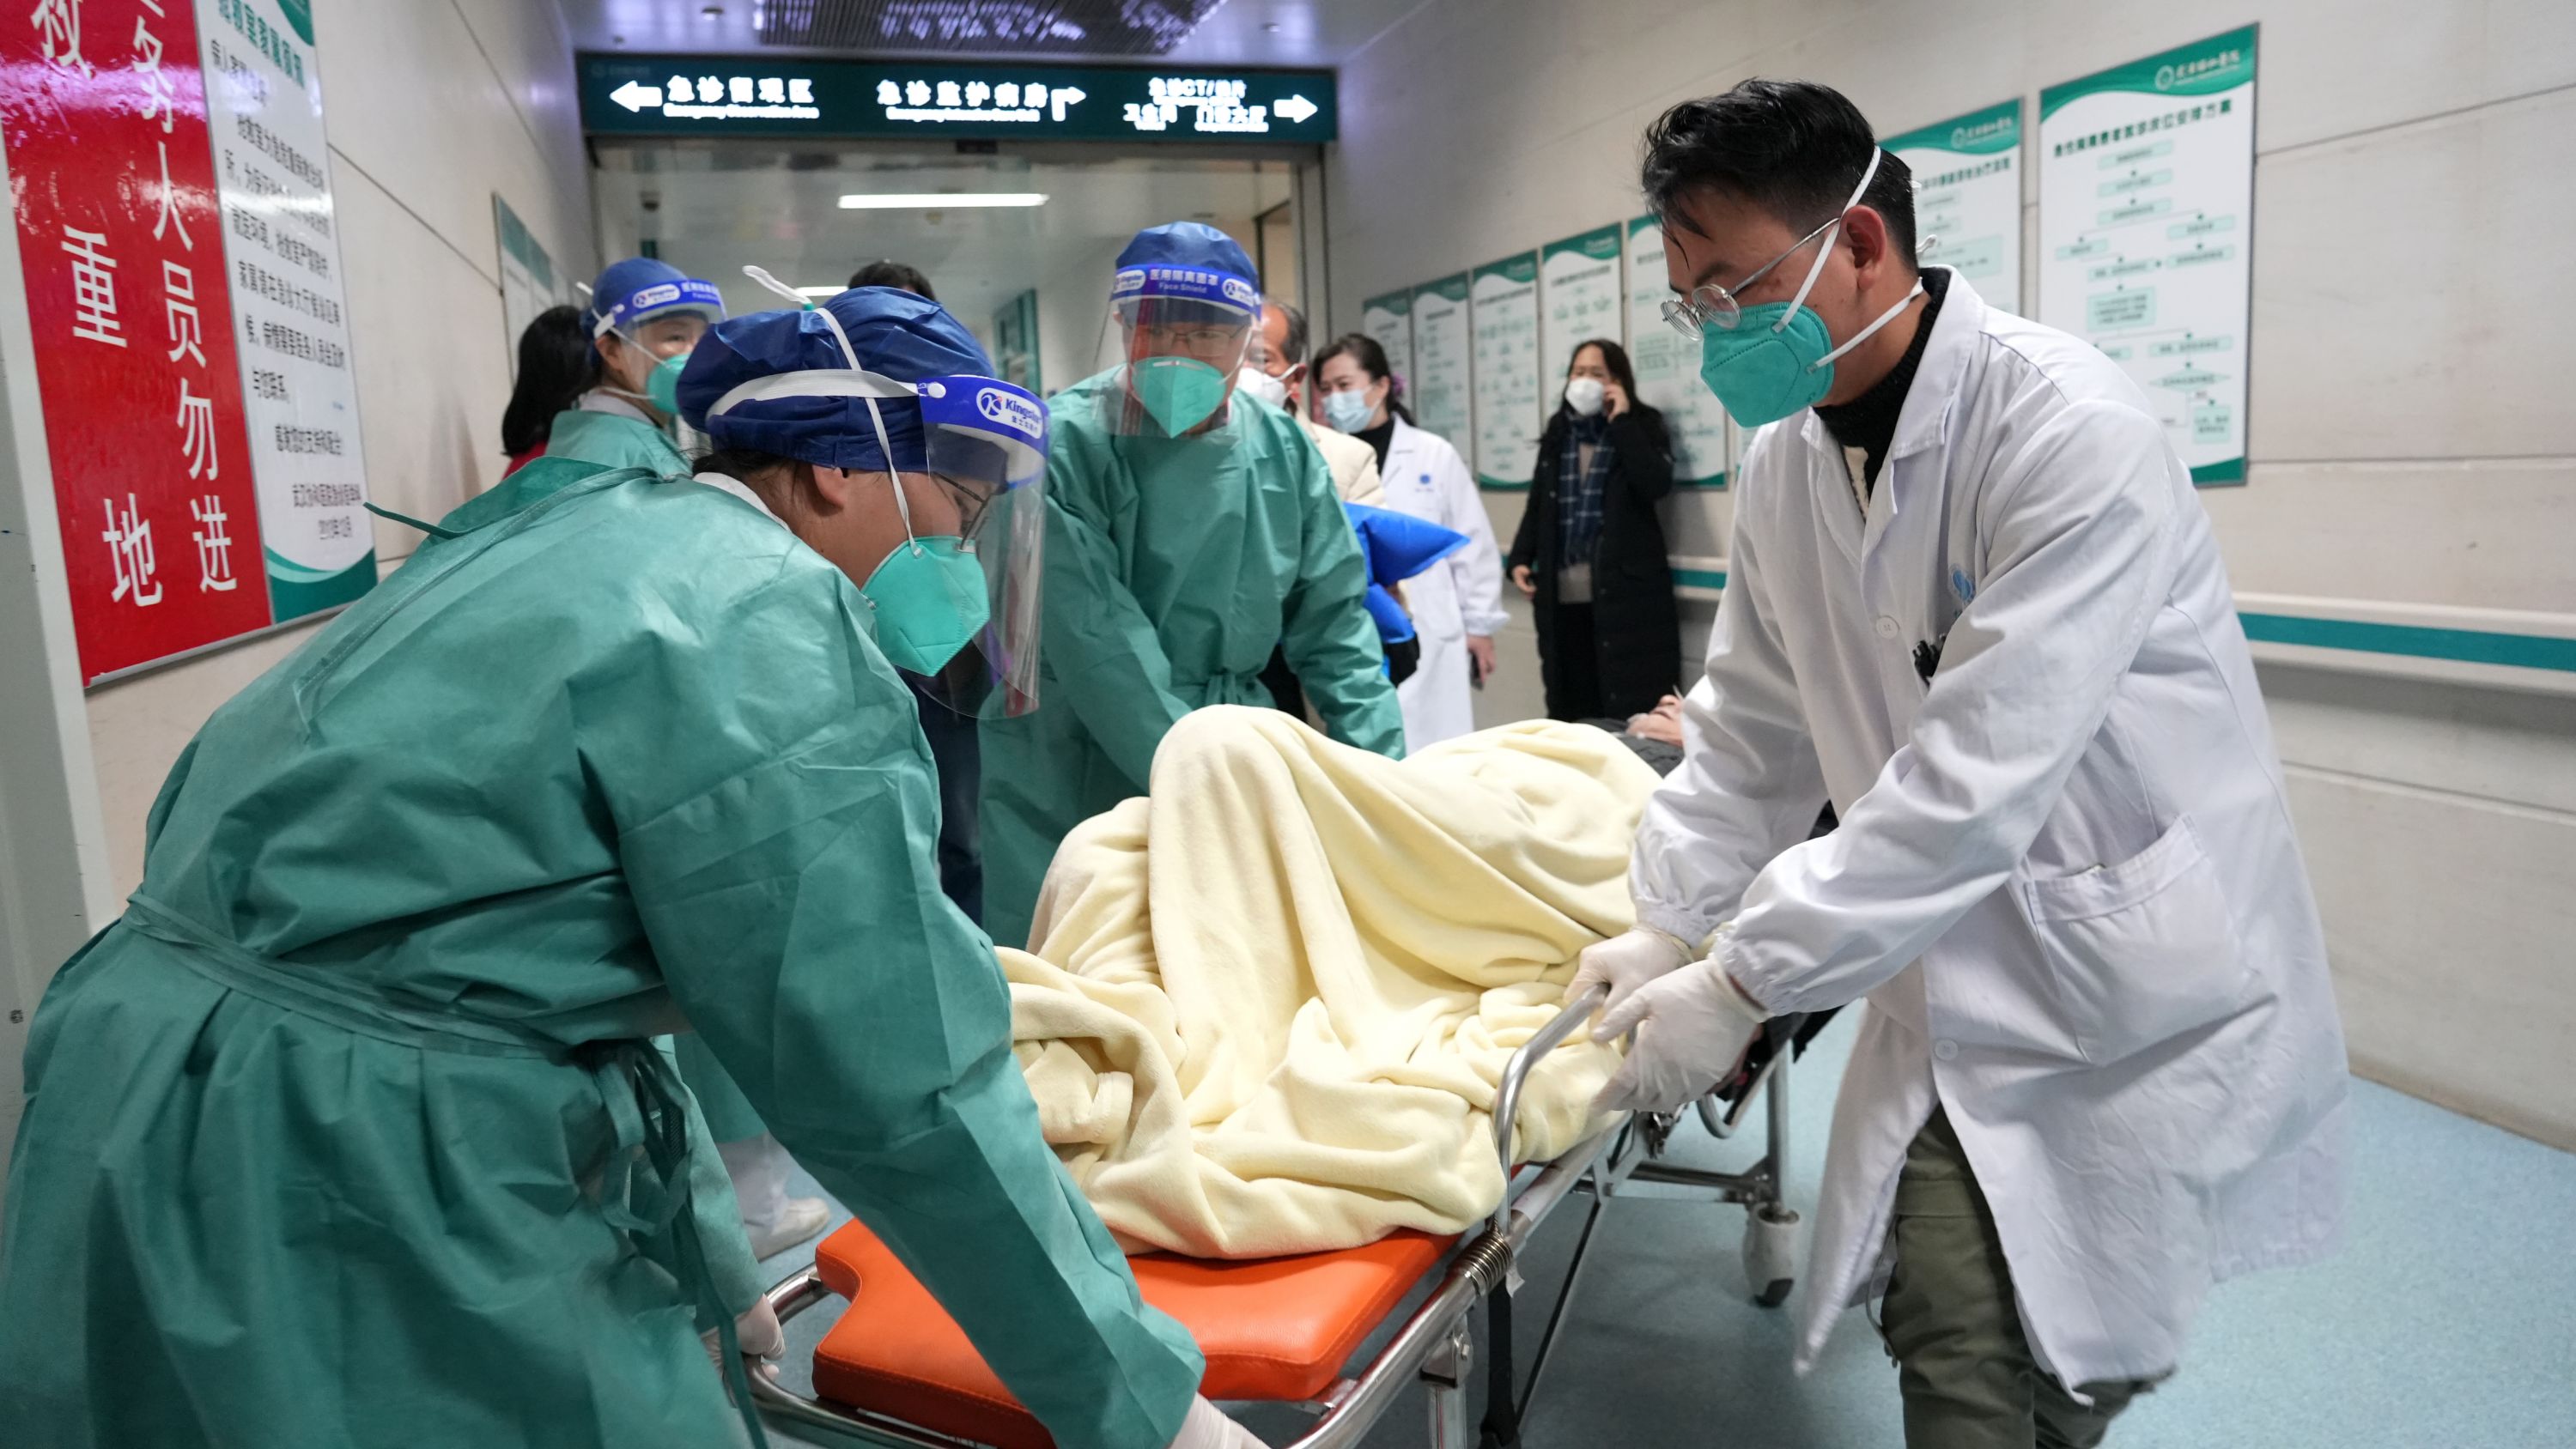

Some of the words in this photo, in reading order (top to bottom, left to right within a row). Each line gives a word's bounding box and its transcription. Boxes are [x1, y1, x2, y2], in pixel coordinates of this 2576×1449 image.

[131, 0, 238, 593] 务人员勿进
